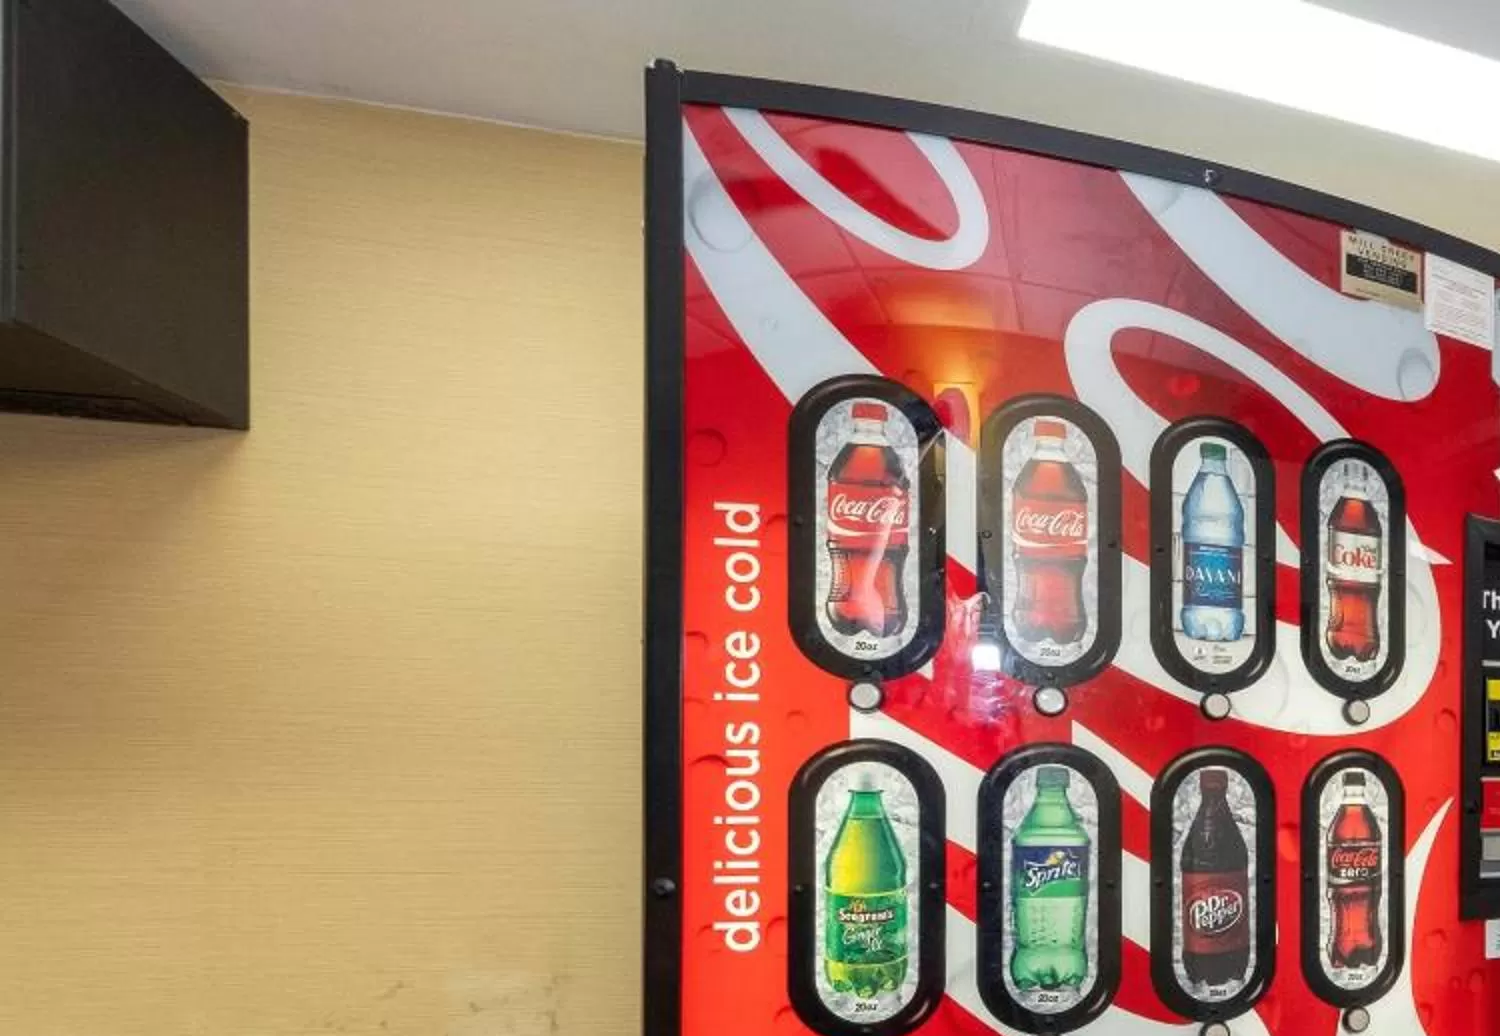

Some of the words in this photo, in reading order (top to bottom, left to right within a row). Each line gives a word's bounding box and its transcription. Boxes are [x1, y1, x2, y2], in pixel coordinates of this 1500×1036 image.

[1016, 506, 1085, 537] Coca-Cola
[713, 501, 761, 612] cold
[1330, 543, 1377, 569] Coke
[713, 630, 761, 702] ice
[713, 720, 761, 953] delicious
[1025, 860, 1079, 888] Sprite
[1340, 867, 1369, 877] zero
[1194, 899, 1238, 930] Pepper
[1207, 895, 1229, 912] Dr
